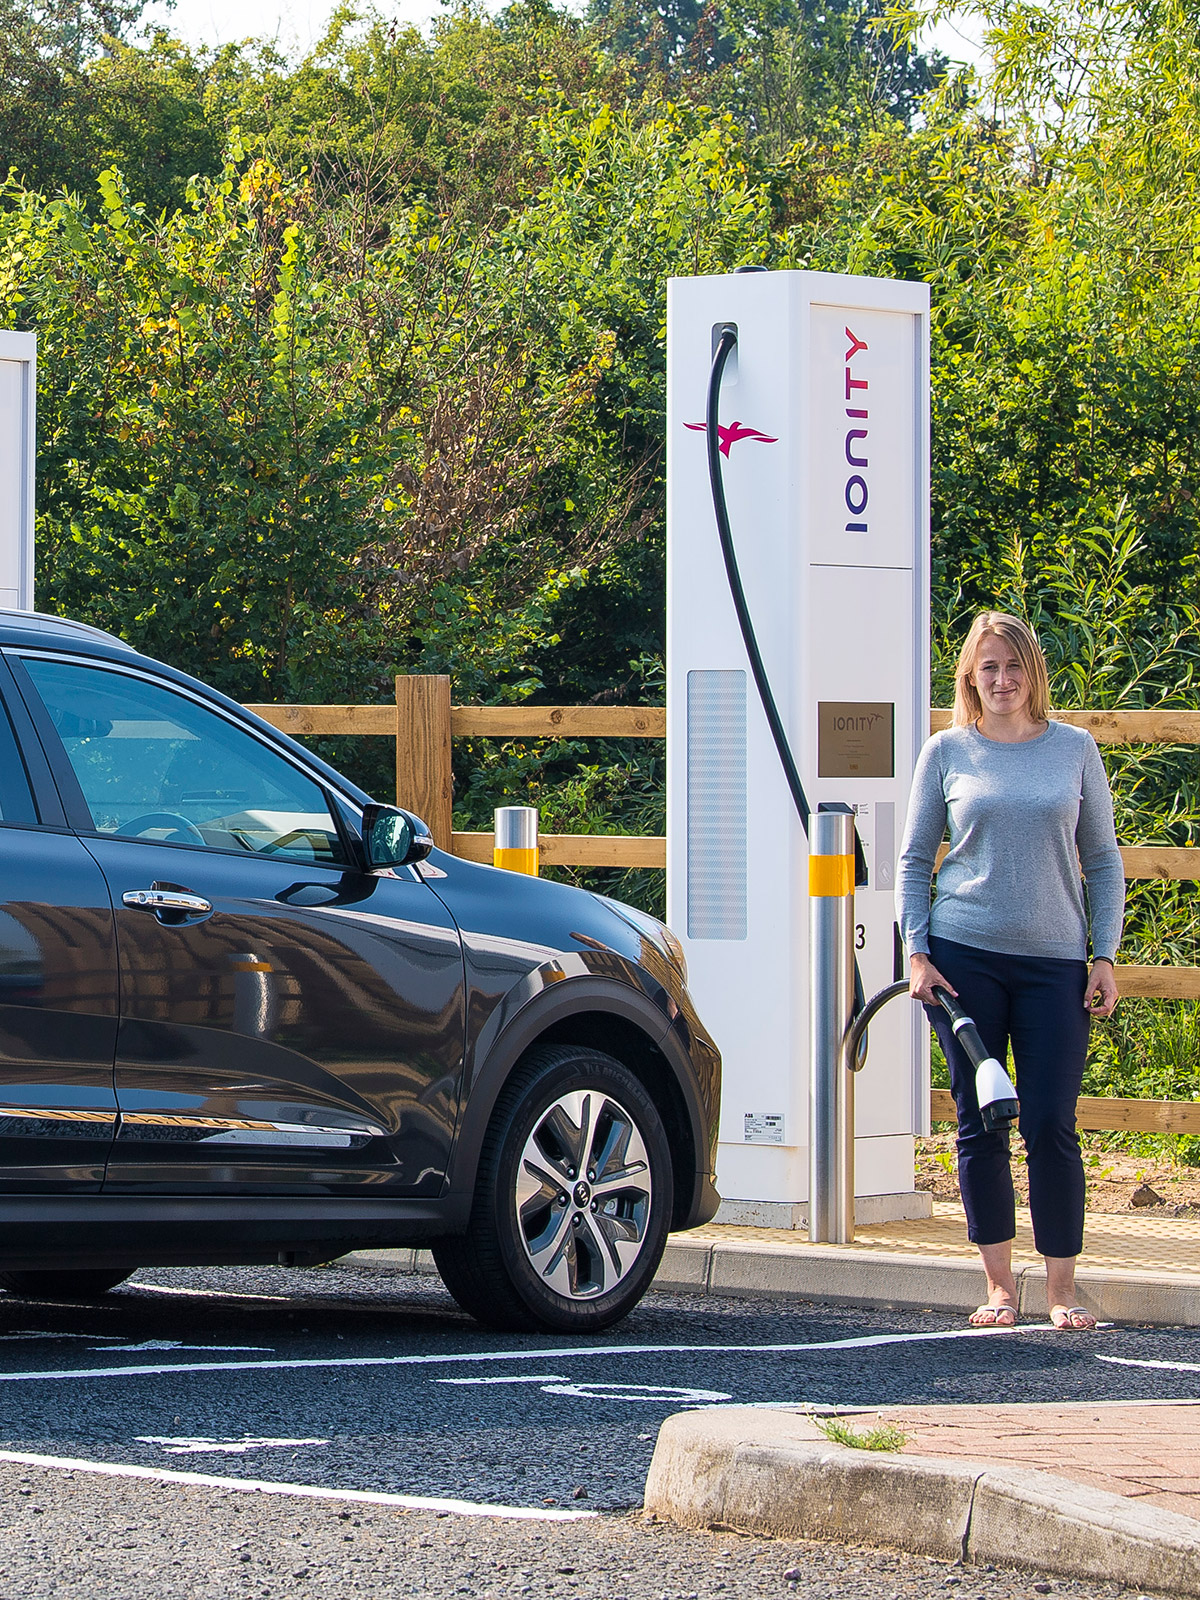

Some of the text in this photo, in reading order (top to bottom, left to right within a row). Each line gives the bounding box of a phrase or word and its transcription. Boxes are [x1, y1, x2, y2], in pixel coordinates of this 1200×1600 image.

[845, 326, 868, 532] IONITY
[833, 716, 874, 731] IONITY
[855, 924, 866, 950] 3
[577, 1184, 588, 1206] KIA
